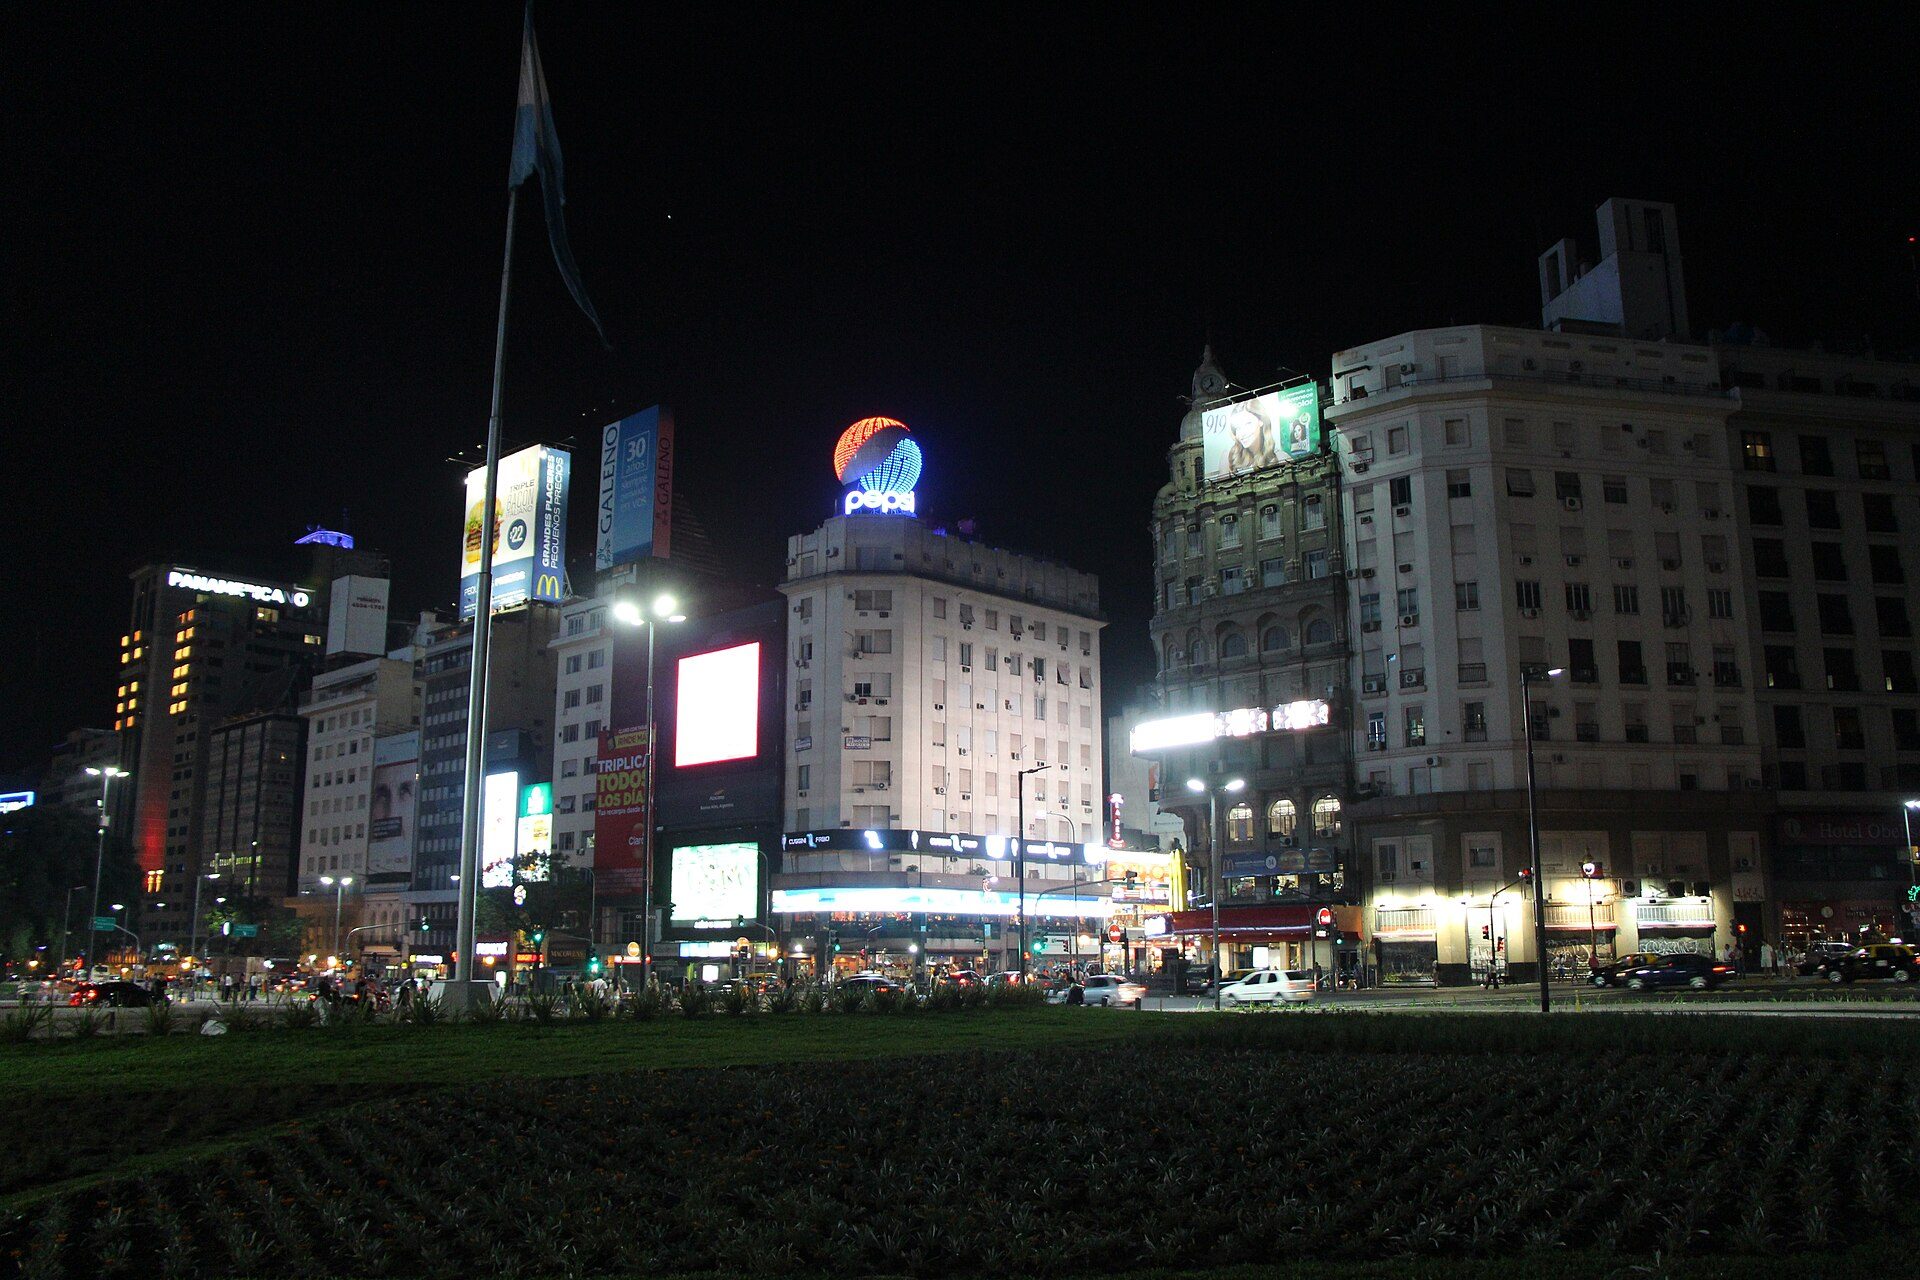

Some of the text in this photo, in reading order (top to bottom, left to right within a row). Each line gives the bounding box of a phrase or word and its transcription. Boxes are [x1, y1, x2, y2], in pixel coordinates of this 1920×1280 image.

[626, 437, 646, 462] 30
[554, 456, 564, 507] PRECIOS
[601, 426, 618, 534] GALENO
[657, 436, 671, 505] GALENO
[510, 478, 535, 492] TRIPLE
[542, 455, 555, 567] GRANDES PLACERES
[509, 525, 524, 543] $22
[598, 788, 645, 808] LOS DÍA
[1819, 822, 1863, 839] Hotel
